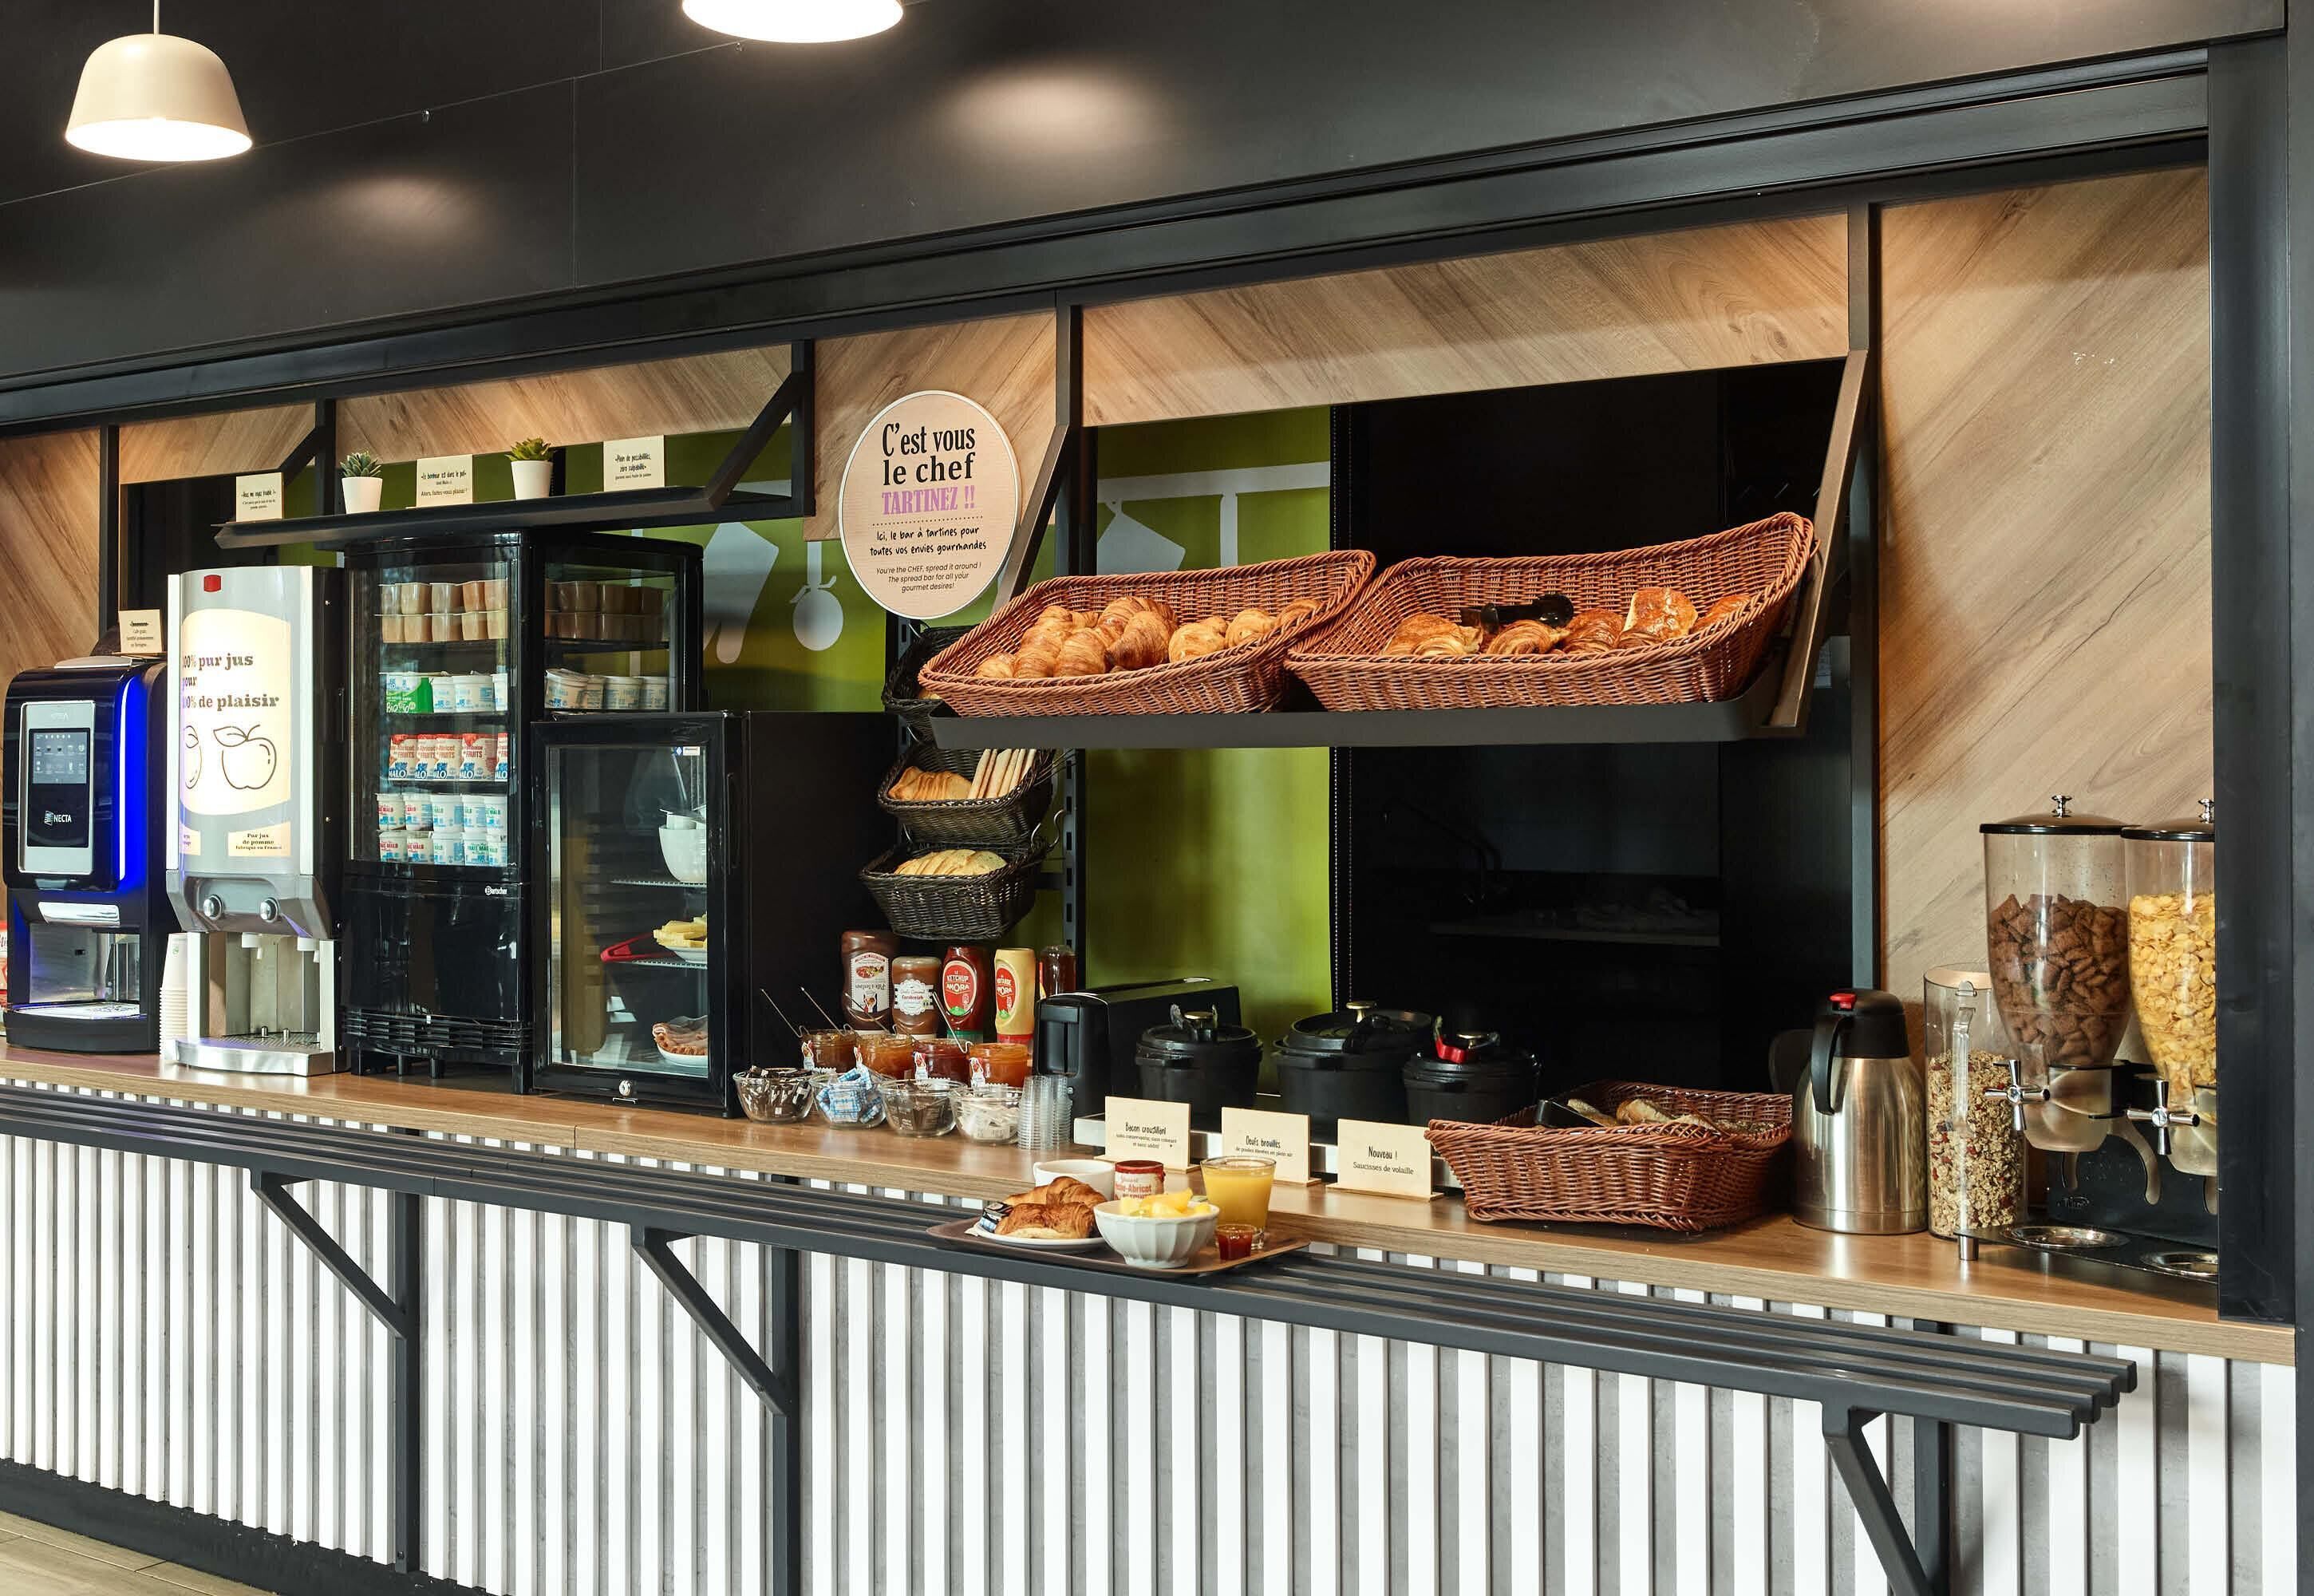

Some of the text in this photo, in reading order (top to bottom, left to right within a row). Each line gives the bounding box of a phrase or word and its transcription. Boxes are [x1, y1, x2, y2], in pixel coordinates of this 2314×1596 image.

[932, 428, 976, 452] vous
[883, 452, 976, 486] le chef
[882, 484, 975, 516] TARTINEZ !!
[877, 527, 980, 541] Ici, le bar à tartines pour
[870, 539, 987, 556] toutes vos envies gourmandes
[926, 563, 948, 573] spread
[900, 575, 922, 584] spread
[954, 572, 969, 582] your
[902, 584, 929, 594] gourmet
[199, 656, 223, 671] pur
[224, 652, 254, 671] jus
[199, 695, 214, 708] de
[216, 693, 280, 712] plaisir
[53, 814, 72, 824] NECTA
[946, 982, 970, 993] AMORA
[1125, 1121, 1140, 1132] Bacon
[1368, 1145, 1392, 1159] Nouveau
[1352, 1161, 1382, 1171] Saucisses
[1392, 1166, 1415, 1175] volaille
